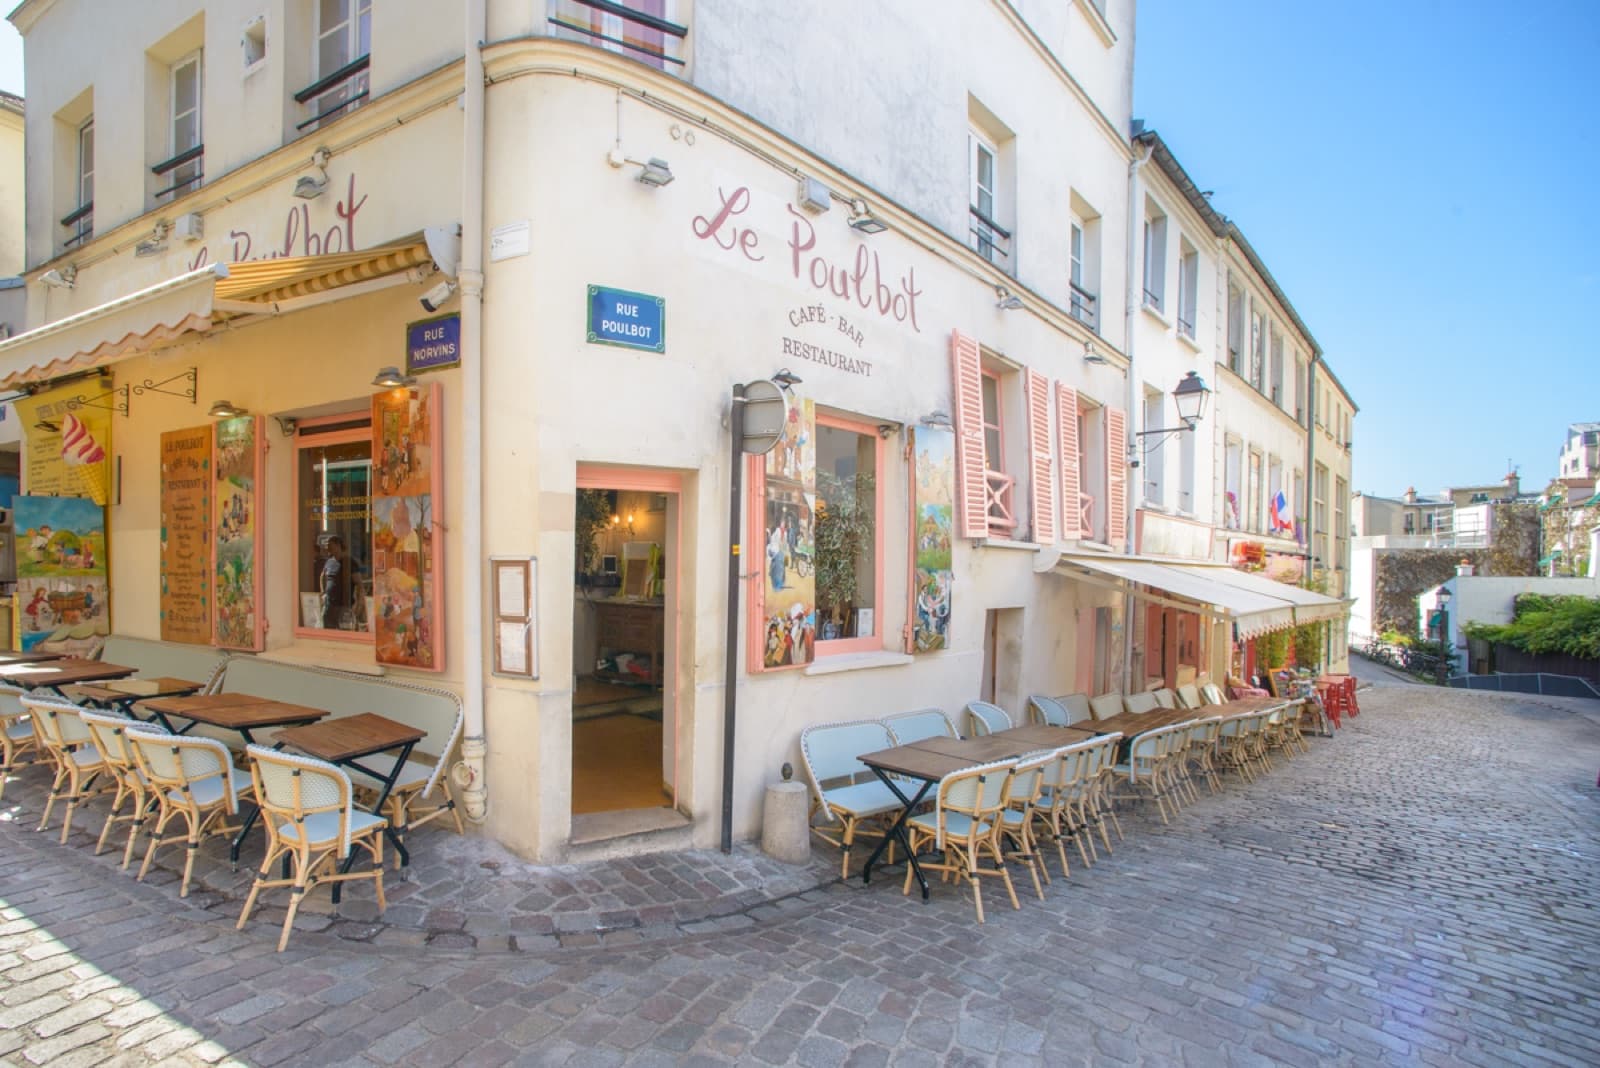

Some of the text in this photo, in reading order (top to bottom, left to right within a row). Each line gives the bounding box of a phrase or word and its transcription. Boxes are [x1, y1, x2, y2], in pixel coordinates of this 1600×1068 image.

[692, 186, 923, 334] Le Poulbot
[616, 302, 639, 318] RUE
[424, 327, 445, 342] RUE
[602, 319, 652, 339] POULBOT
[788, 302, 827, 328] CAFÉ
[837, 314, 865, 349] BAR
[413, 343, 456, 362] NORVINS
[781, 336, 873, 377] RESTAURANT
